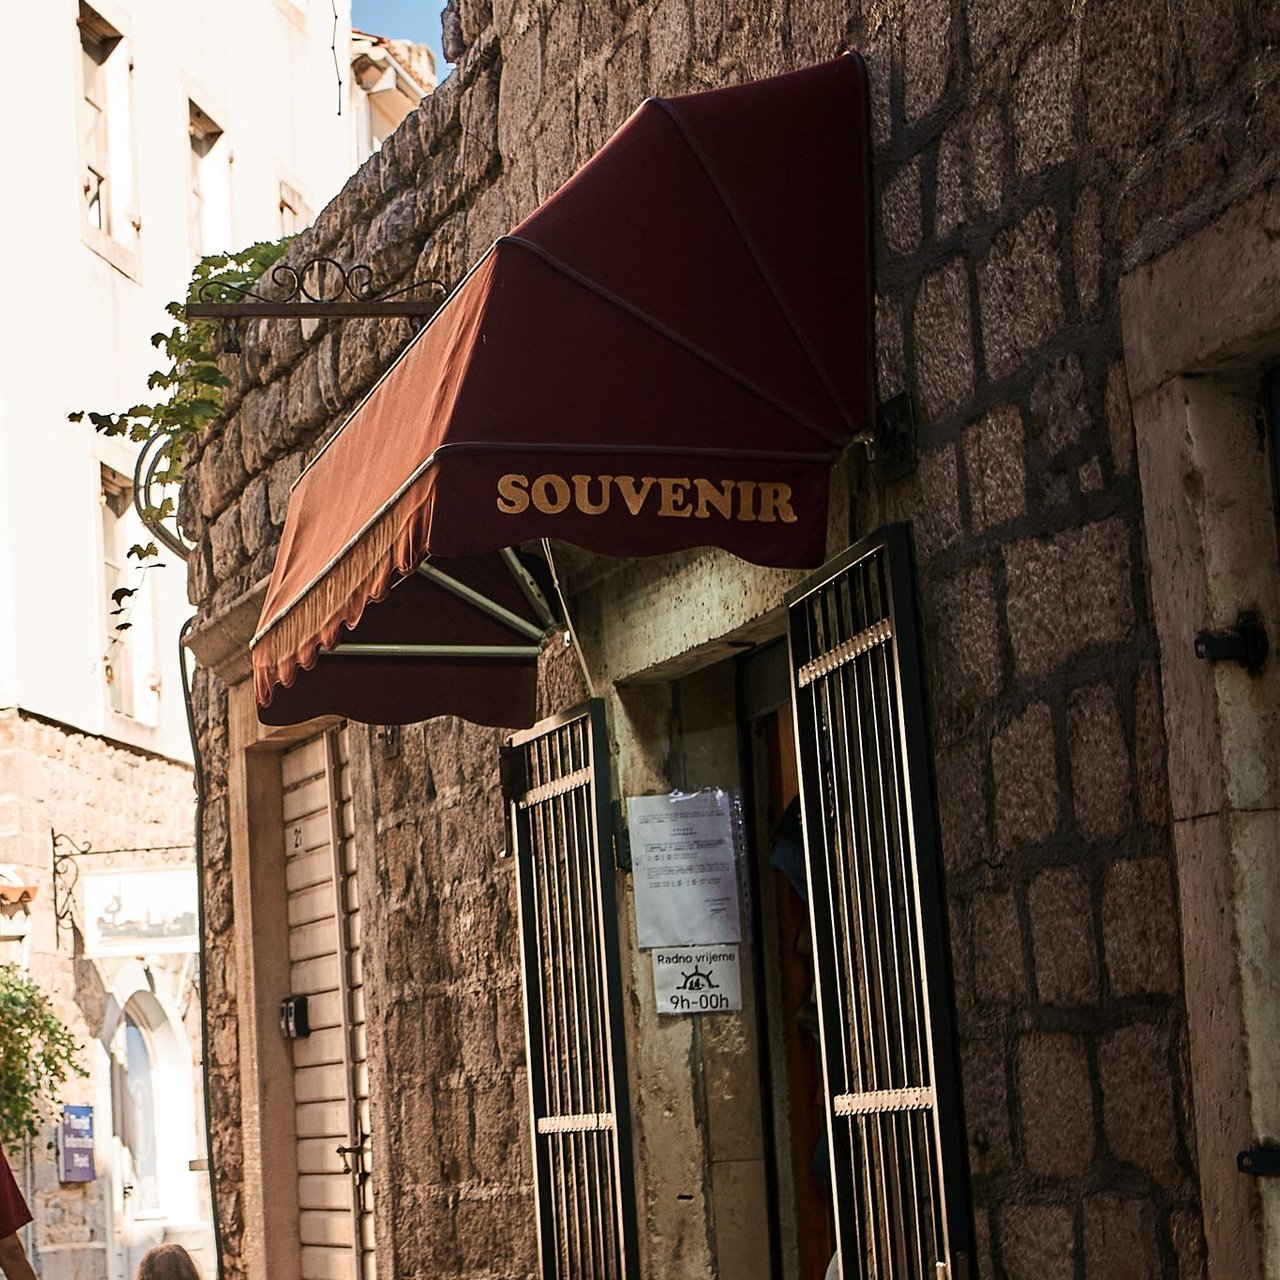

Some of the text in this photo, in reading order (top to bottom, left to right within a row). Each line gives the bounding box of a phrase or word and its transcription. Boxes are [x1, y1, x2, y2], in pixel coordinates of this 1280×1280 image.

[496, 473, 798, 523] SOUVENIR
[657, 951, 736, 965] Radno vrijeme
[669, 993, 729, 1010] 9h-00h
